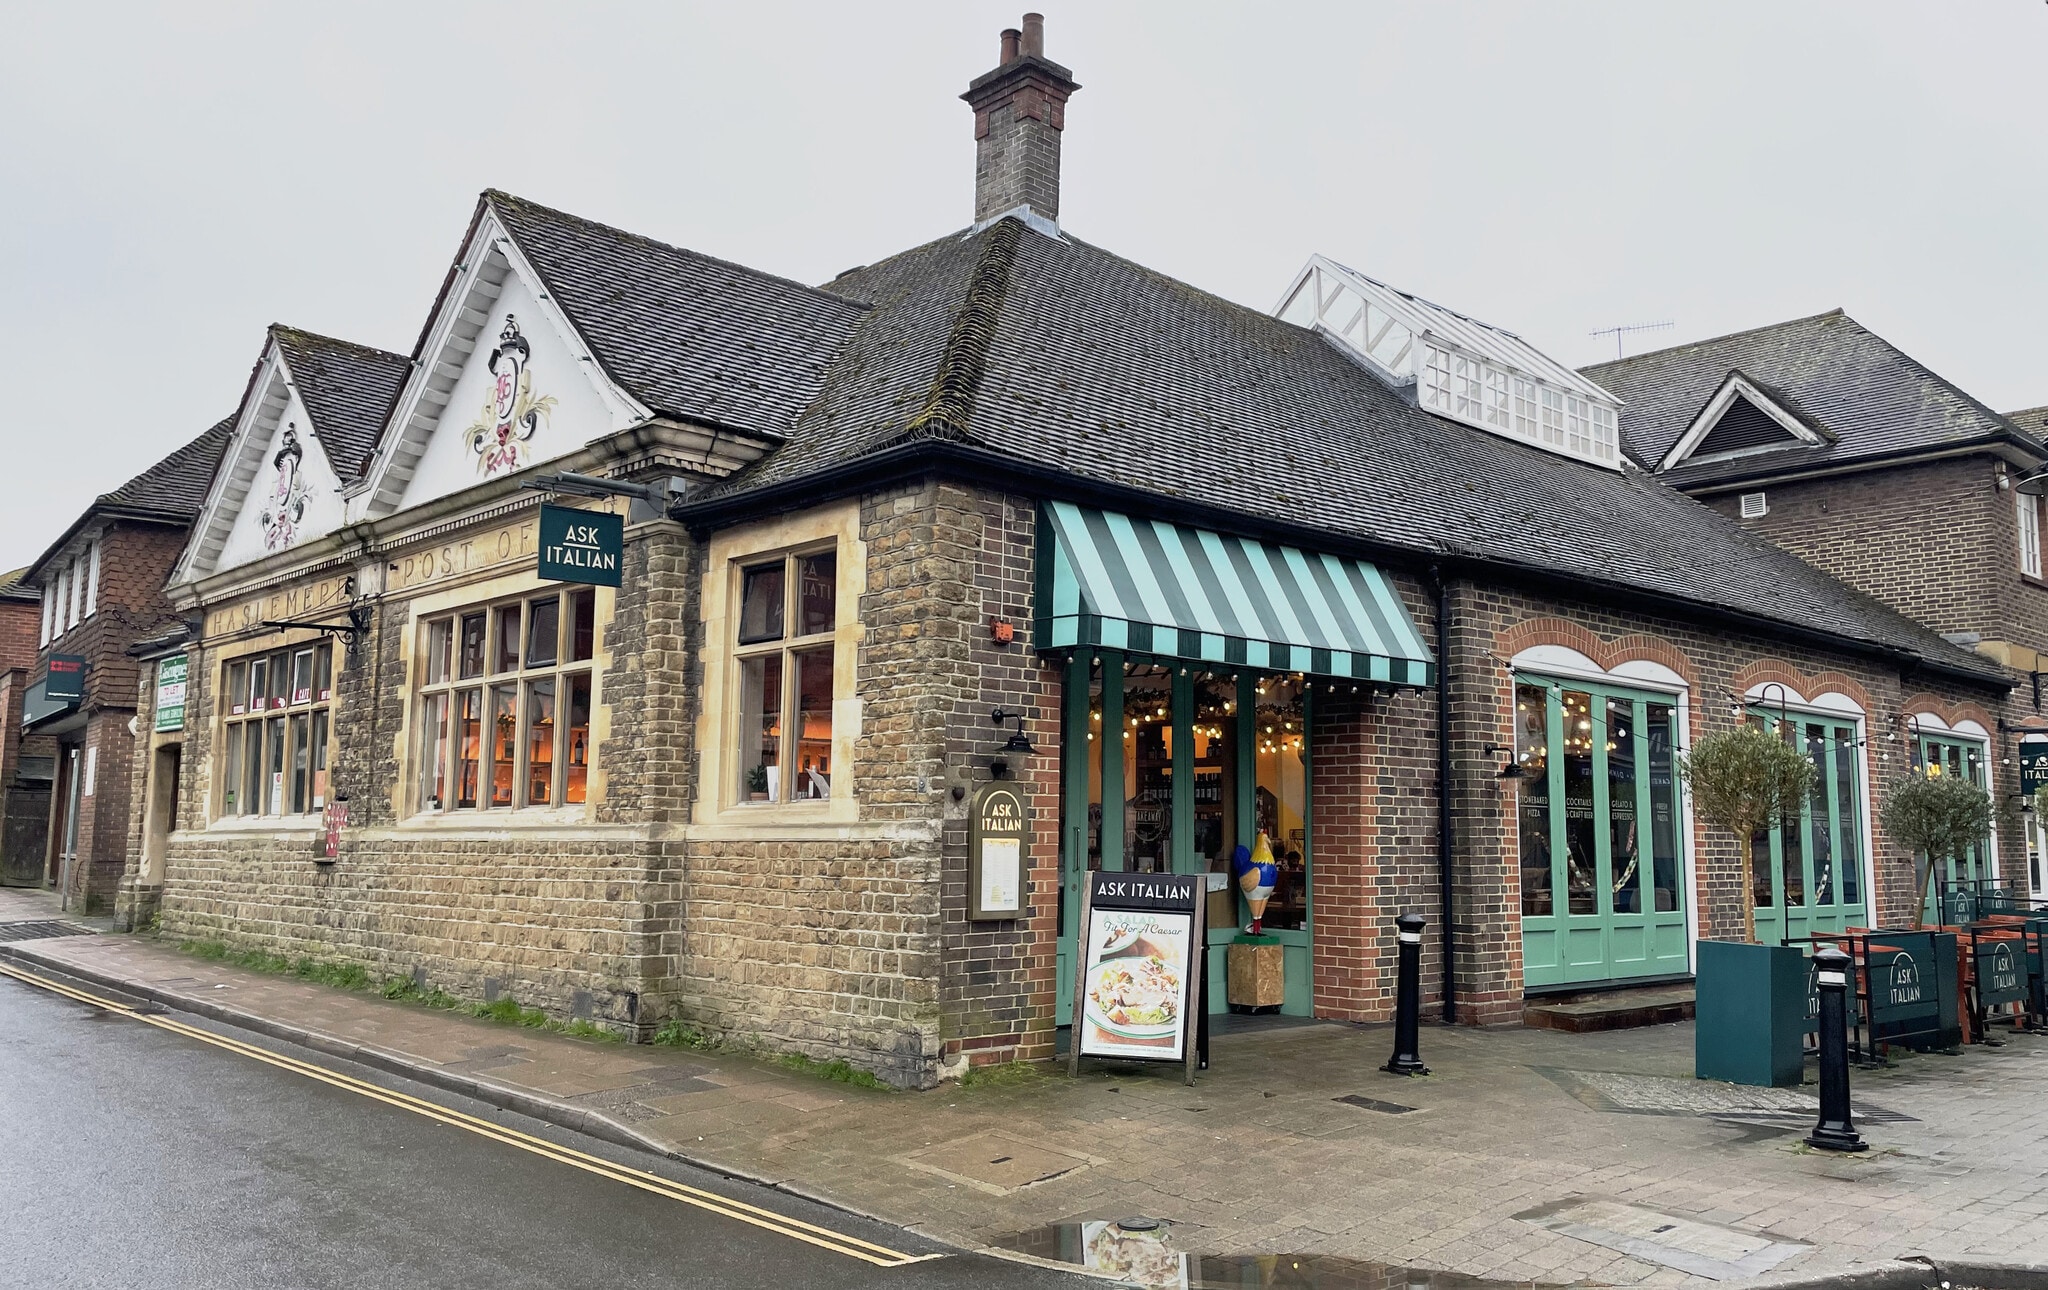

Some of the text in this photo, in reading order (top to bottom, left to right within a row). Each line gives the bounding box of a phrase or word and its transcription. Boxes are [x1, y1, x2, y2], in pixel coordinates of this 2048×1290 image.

[565, 525, 599, 545] ASK
[402, 541, 474, 585] POST
[546, 546, 616, 570] ITALIAN
[213, 577, 348, 635] HASLEMERE
[2035, 757, 2048, 767] AS
[2024, 770, 2048, 779] ITAL
[1519, 796, 1548, 805] STONEBAKED
[1566, 798, 1592, 807] COCKTAILS
[1611, 800, 1628, 809] GELATO
[992, 804, 1012, 816] ASK
[1135, 811, 1162, 822] AKEAWAY
[1527, 809, 1541, 817] PIZZA
[1570, 810, 1584, 819] CRAFT
[1584, 811, 1594, 819] BEER
[1611, 812, 1634, 821] ESPRESSO
[982, 818, 1022, 831] ITALIAN
[1098, 882, 1190, 900] ASK ITALIAN
[1104, 920, 1119, 932] Fit
[1121, 922, 1138, 933] For
[1150, 924, 1182, 935] Caesar
[1998, 957, 2009, 972] ASK
[1898, 968, 1912, 985] ASK
[1994, 973, 2016, 989] ITALIAN
[1890, 986, 1920, 1005] ITALIAN
